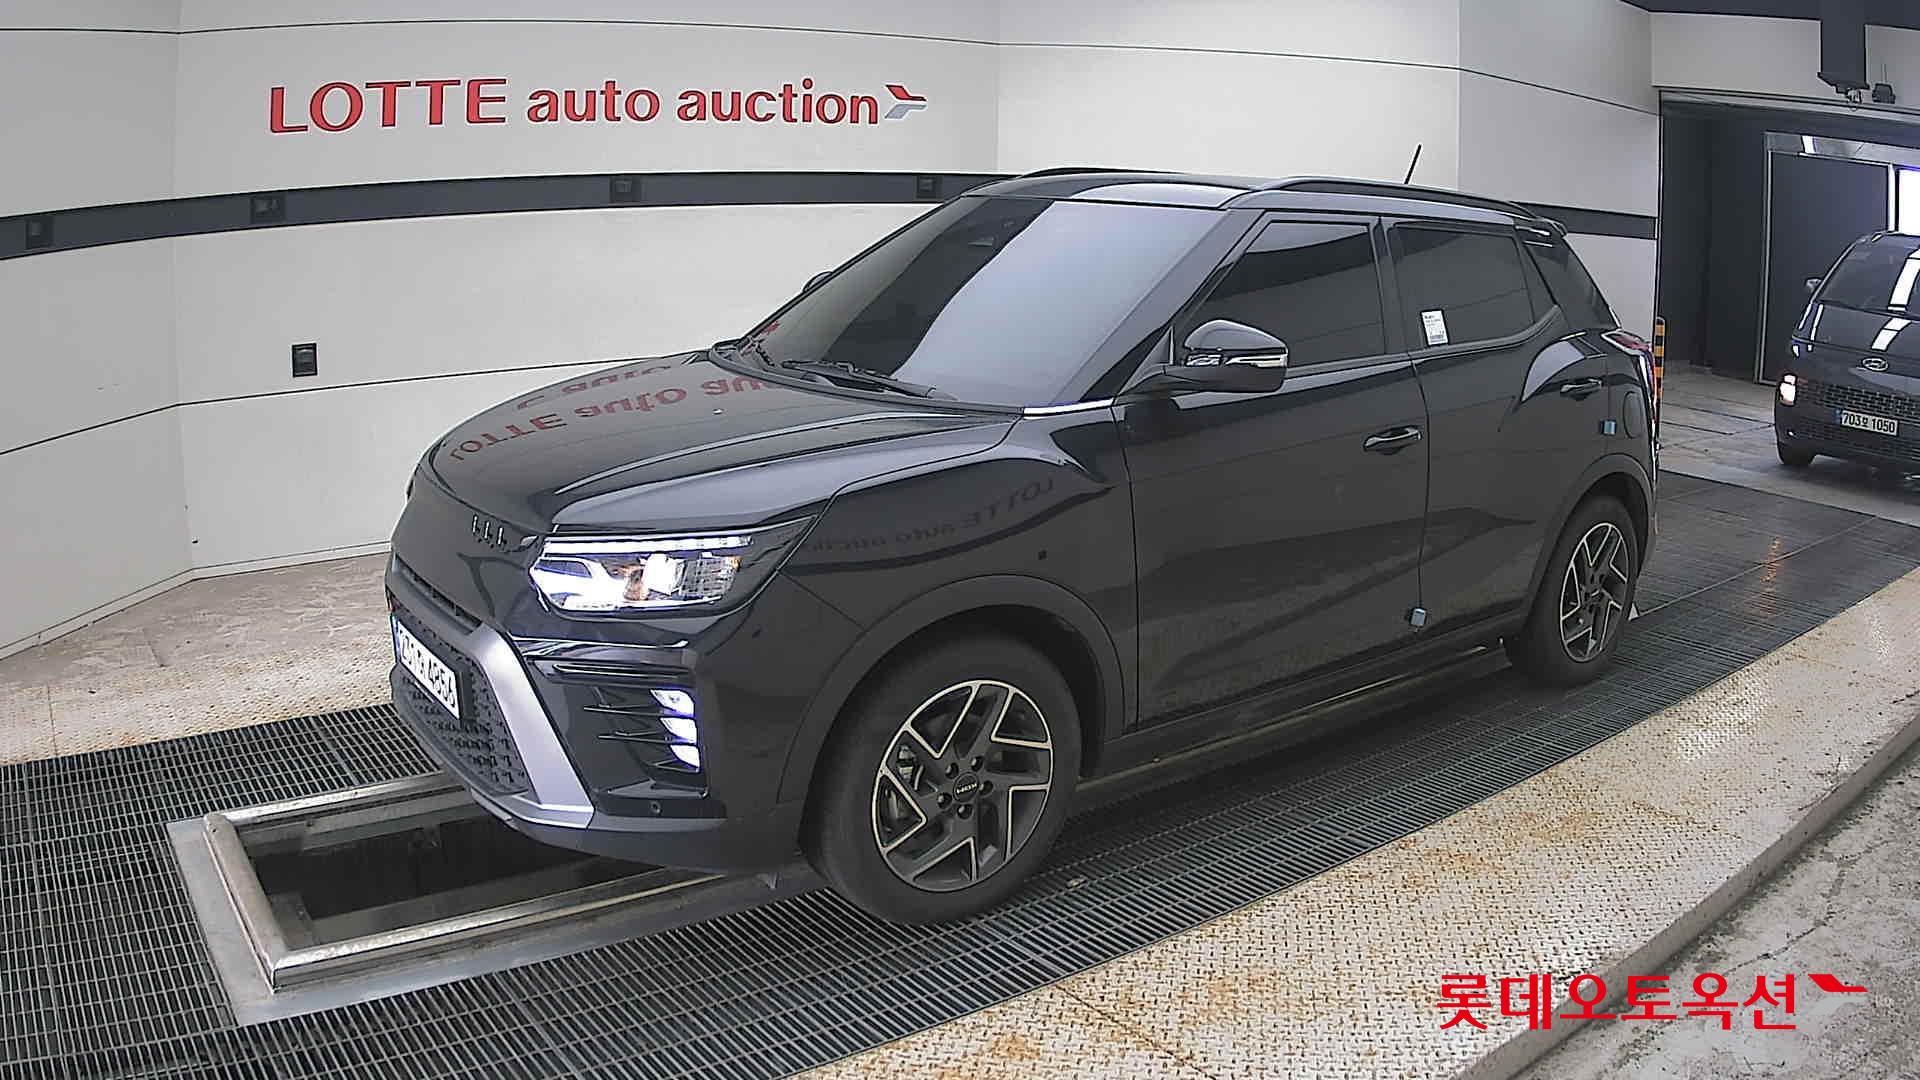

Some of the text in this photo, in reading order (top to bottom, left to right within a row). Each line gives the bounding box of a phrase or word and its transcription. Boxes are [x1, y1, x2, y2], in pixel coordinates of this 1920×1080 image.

[269, 78, 879, 134] LOTTE auto auction
[1872, 418, 1895, 433] 1050
